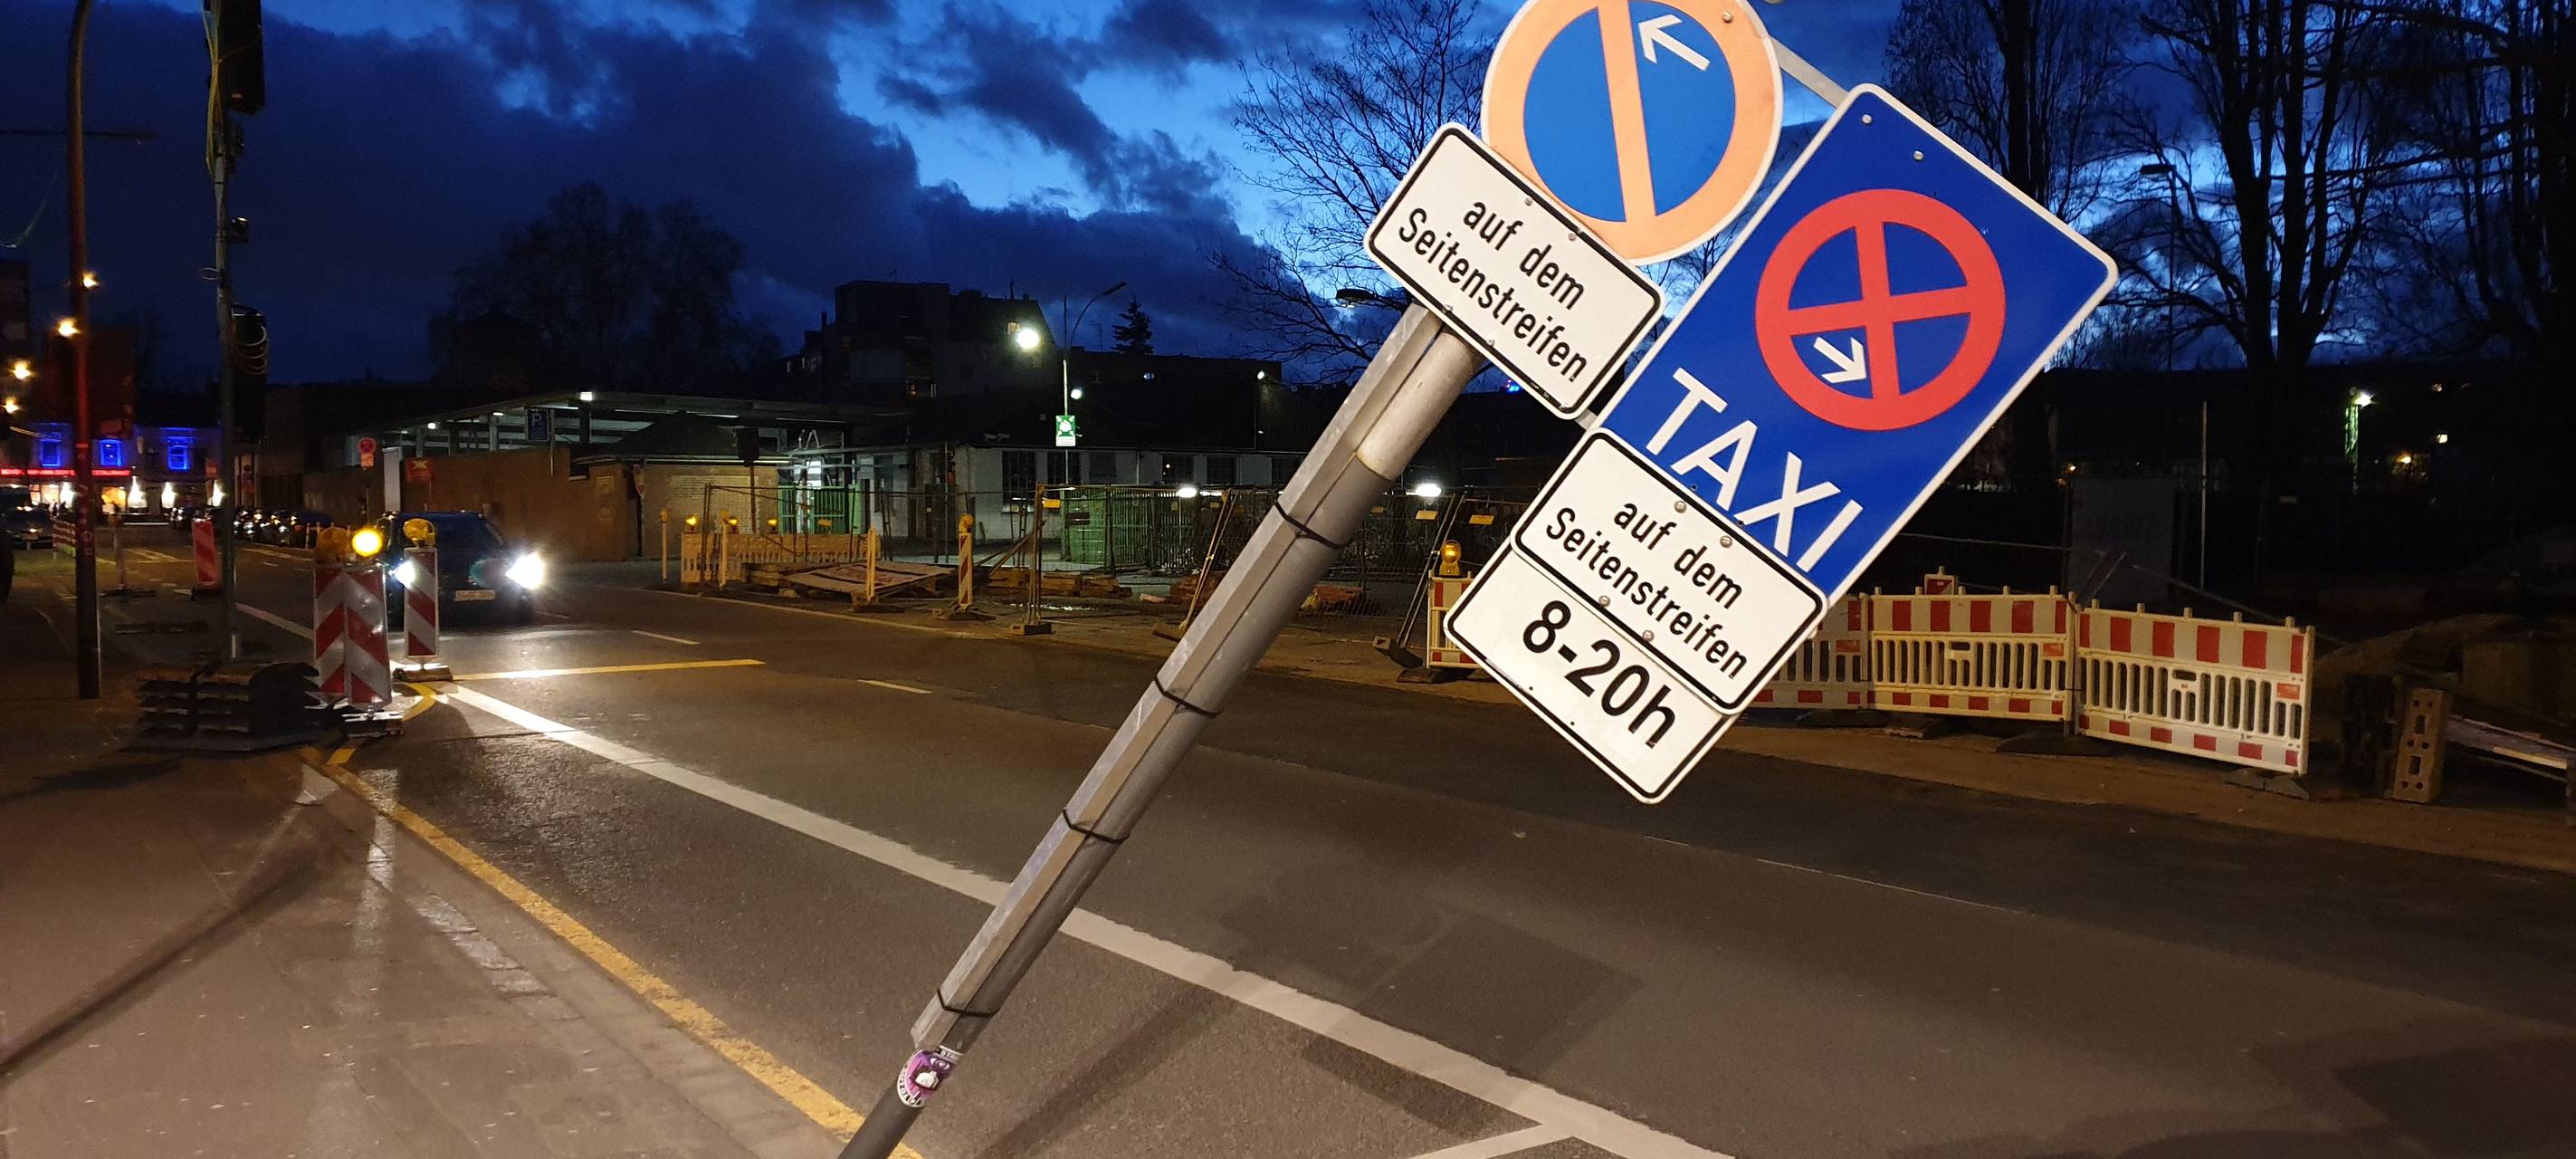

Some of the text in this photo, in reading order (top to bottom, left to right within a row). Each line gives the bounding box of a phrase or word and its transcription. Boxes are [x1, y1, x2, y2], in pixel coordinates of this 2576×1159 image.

[1398, 207, 1588, 380] Seitenstreifen
[1464, 201, 1584, 311] auf dem
[1646, 367, 1863, 573] TAXI
[1546, 507, 1747, 679] Seitenstreifen
[1614, 503, 1742, 609] auf dem
[1522, 600, 1675, 749] 8-20h
